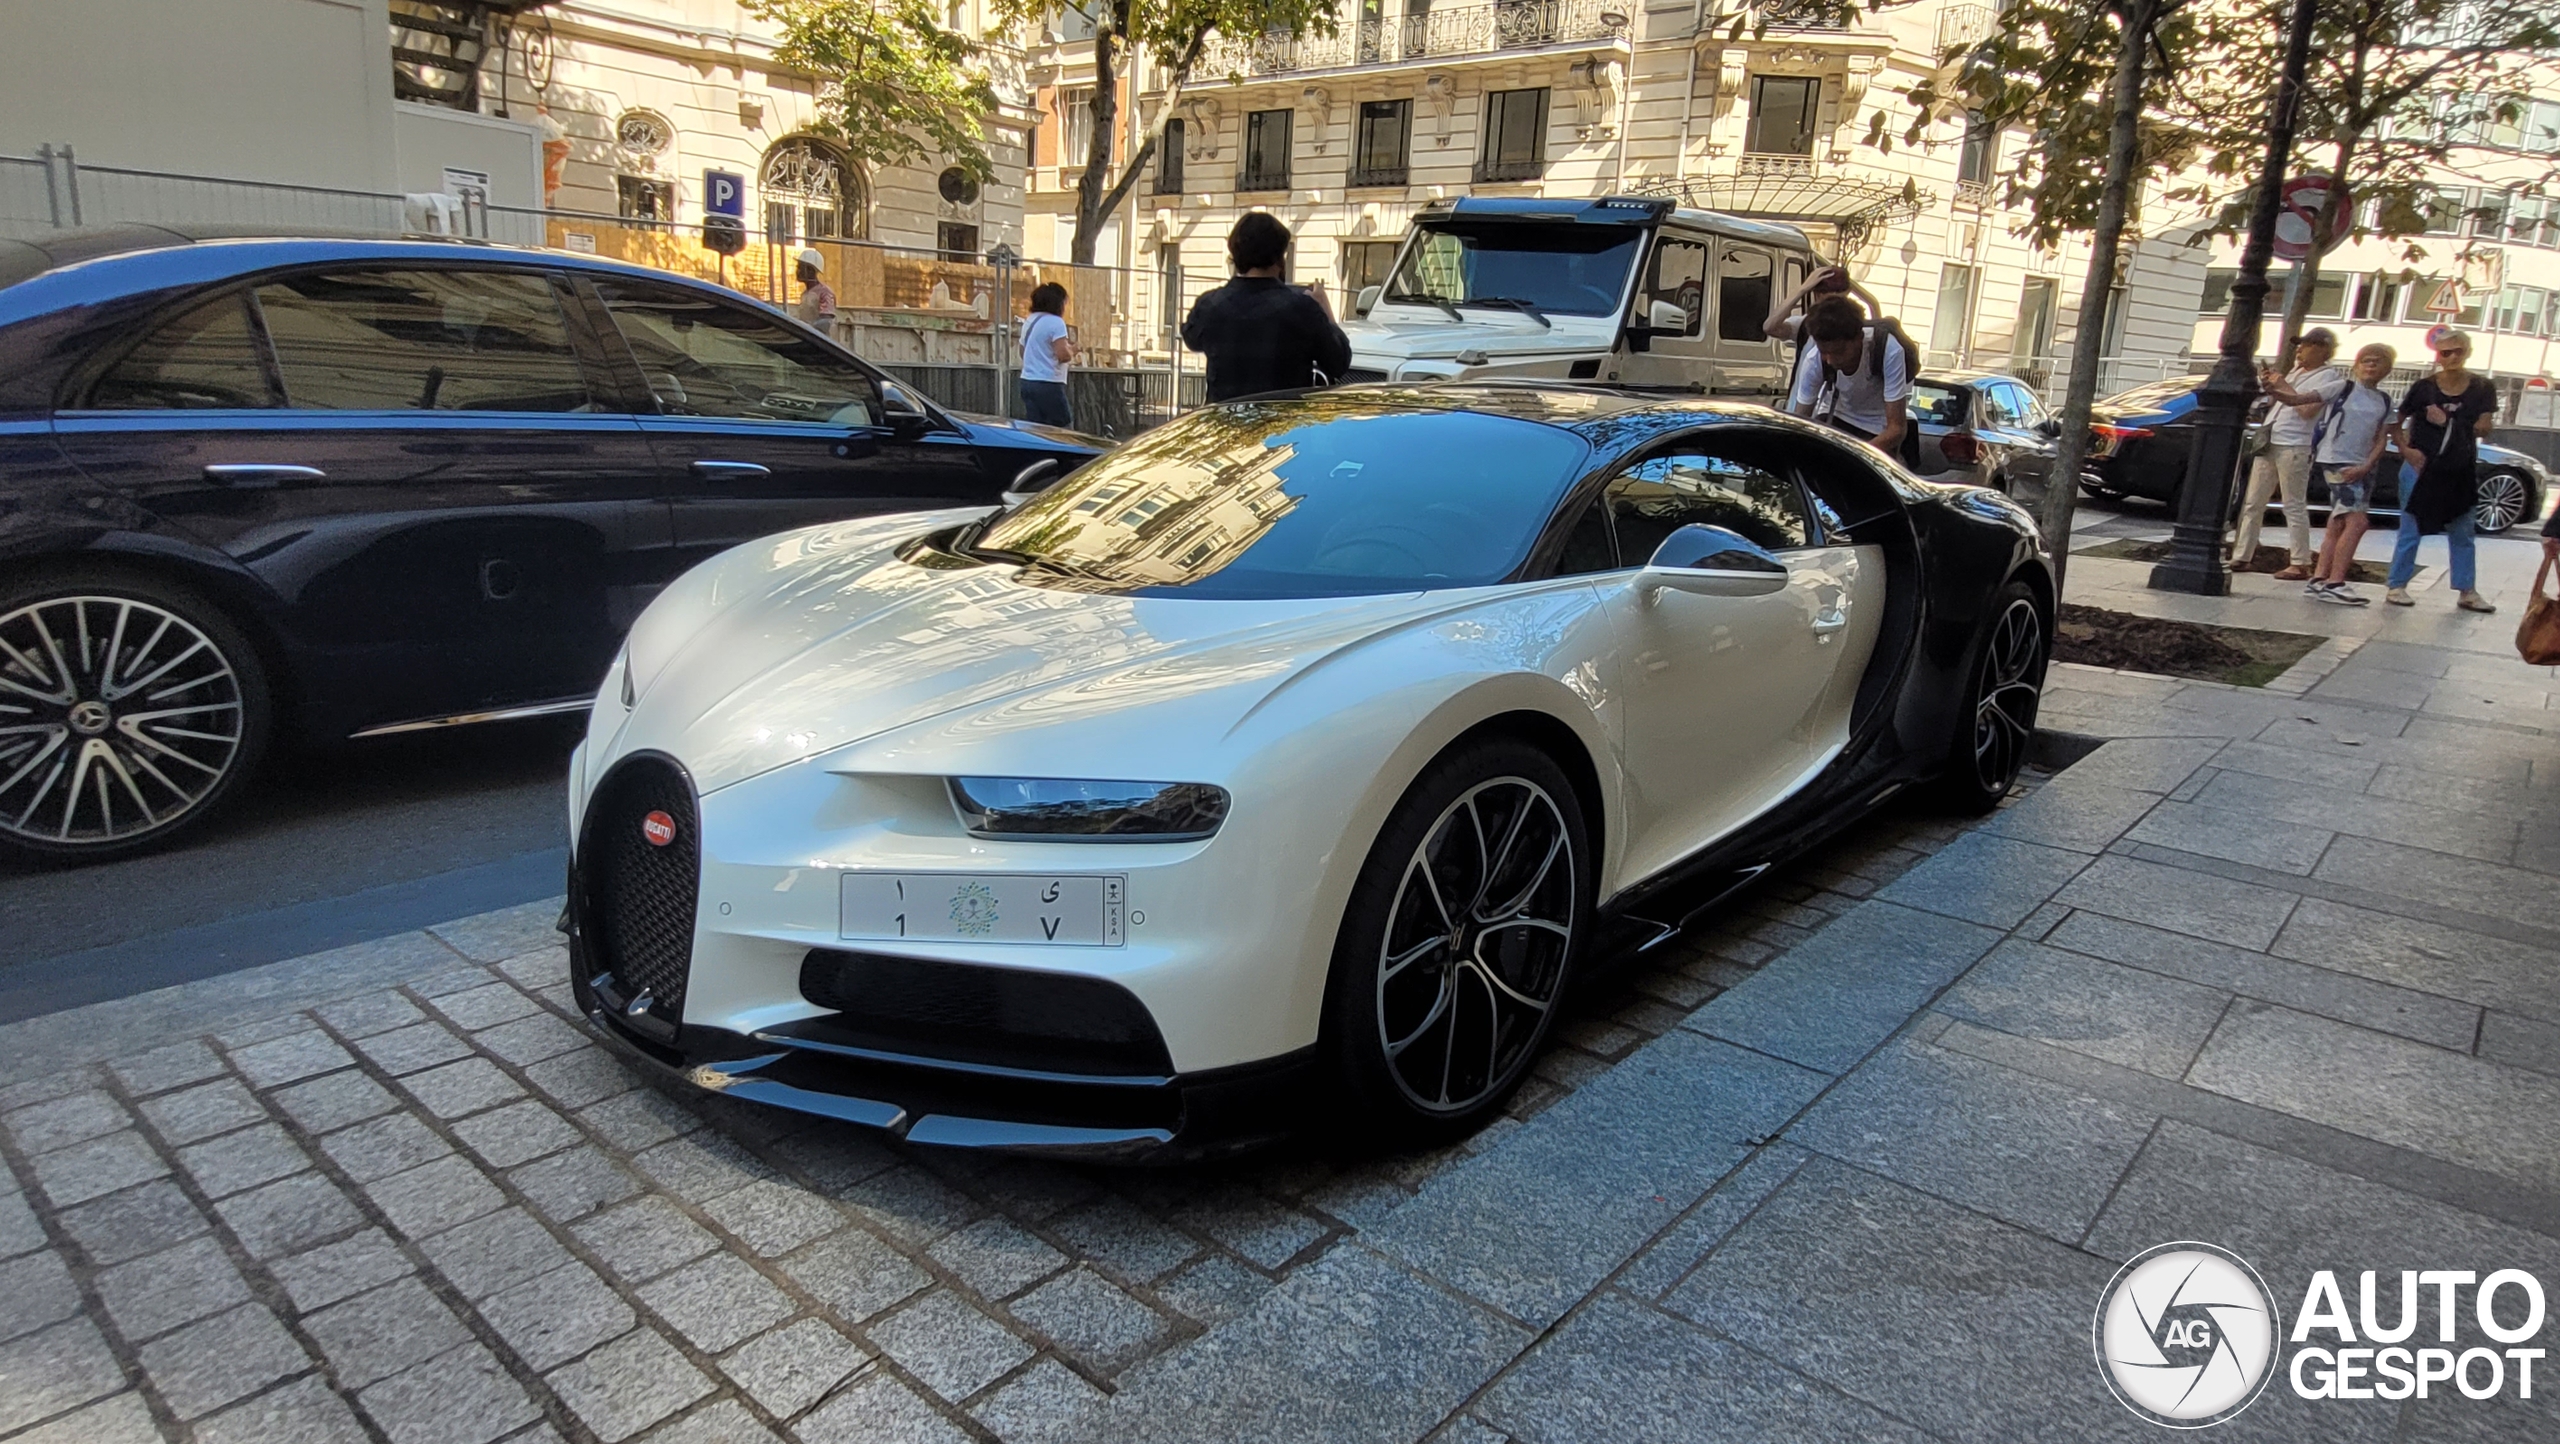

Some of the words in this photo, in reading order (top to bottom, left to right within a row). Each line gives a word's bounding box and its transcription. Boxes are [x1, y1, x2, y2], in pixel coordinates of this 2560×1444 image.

[716, 179, 734, 207] P
[895, 913, 905, 937] 1
[1040, 916, 1061, 941] V
[1110, 907, 1118, 936] KSA
